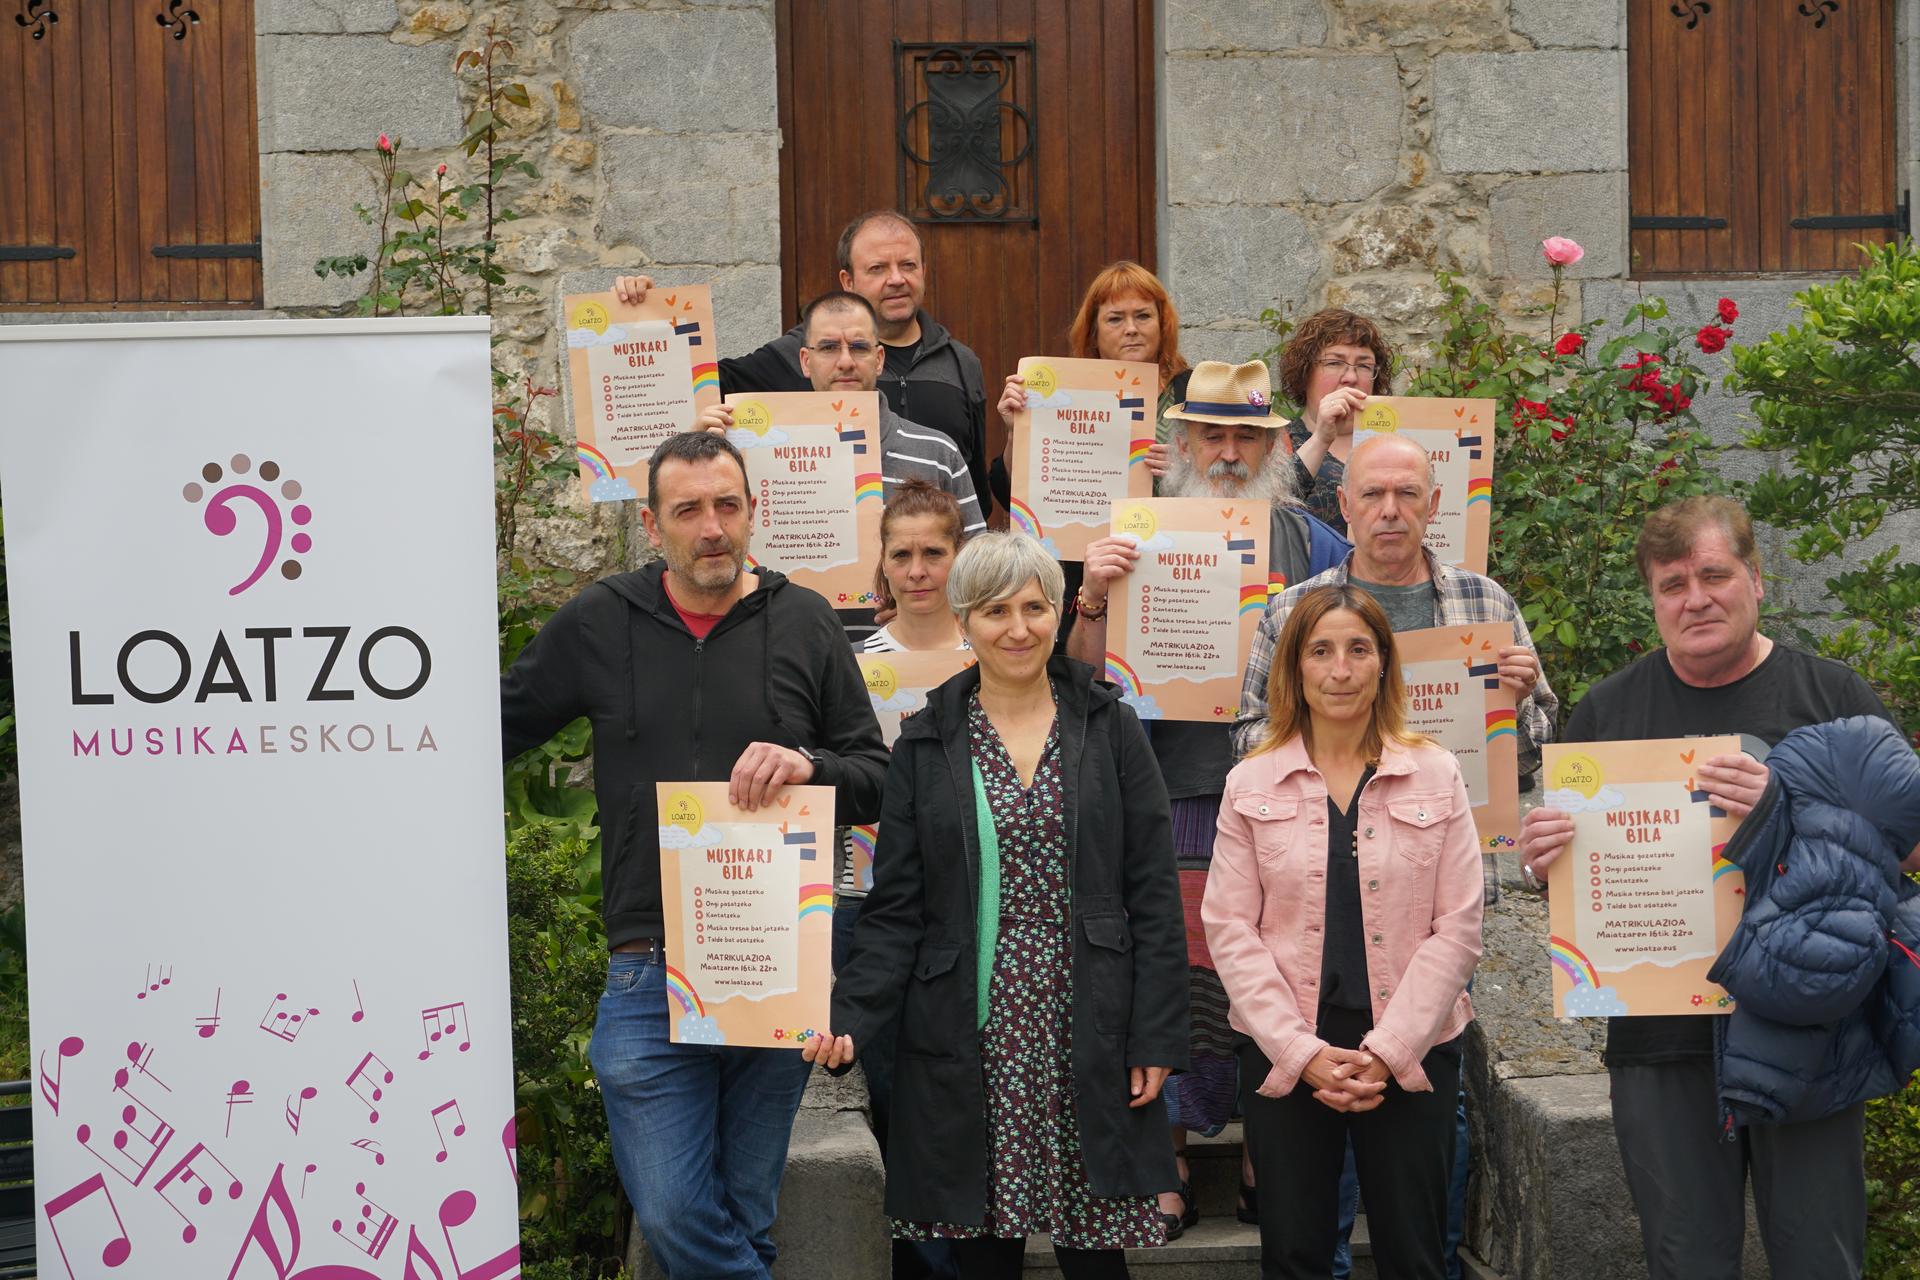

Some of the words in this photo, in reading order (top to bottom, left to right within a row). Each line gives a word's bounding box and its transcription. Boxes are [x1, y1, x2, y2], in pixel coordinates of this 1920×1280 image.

[614, 340, 668, 356] MUSIKARI
[629, 356, 655, 367] BILA
[1057, 409, 1110, 422] MUSIKARI
[1070, 423, 1095, 434] BILA
[774, 446, 831, 459] MUSIKARI
[789, 460, 816, 472] BILA
[1158, 553, 1217, 567] MUSIKARI
[1172, 568, 1201, 580] BILA
[1150, 642, 1215, 650] MATRIKULAZIOA
[70, 626, 431, 705] LOATZO
[1407, 682, 1459, 697] USIKARI
[1413, 698, 1443, 711] BILA
[73, 724, 438, 757] MUSIKAESKOLA
[1561, 775, 1592, 784] LOATZO
[1606, 809, 1680, 827] MUSIKARI
[1626, 828, 1661, 843] BILA
[707, 848, 772, 863] MUSIKARI
[723, 865, 754, 880] BILA
[1605, 919, 1686, 928] MATRIKULAZIOA
[1596, 930, 1647, 939] Maiatzaren
[1650, 929, 1669, 937] 16tik
[1672, 929, 1693, 937] 22ra
[707, 954, 771, 962] MATRIKULAZIOA
